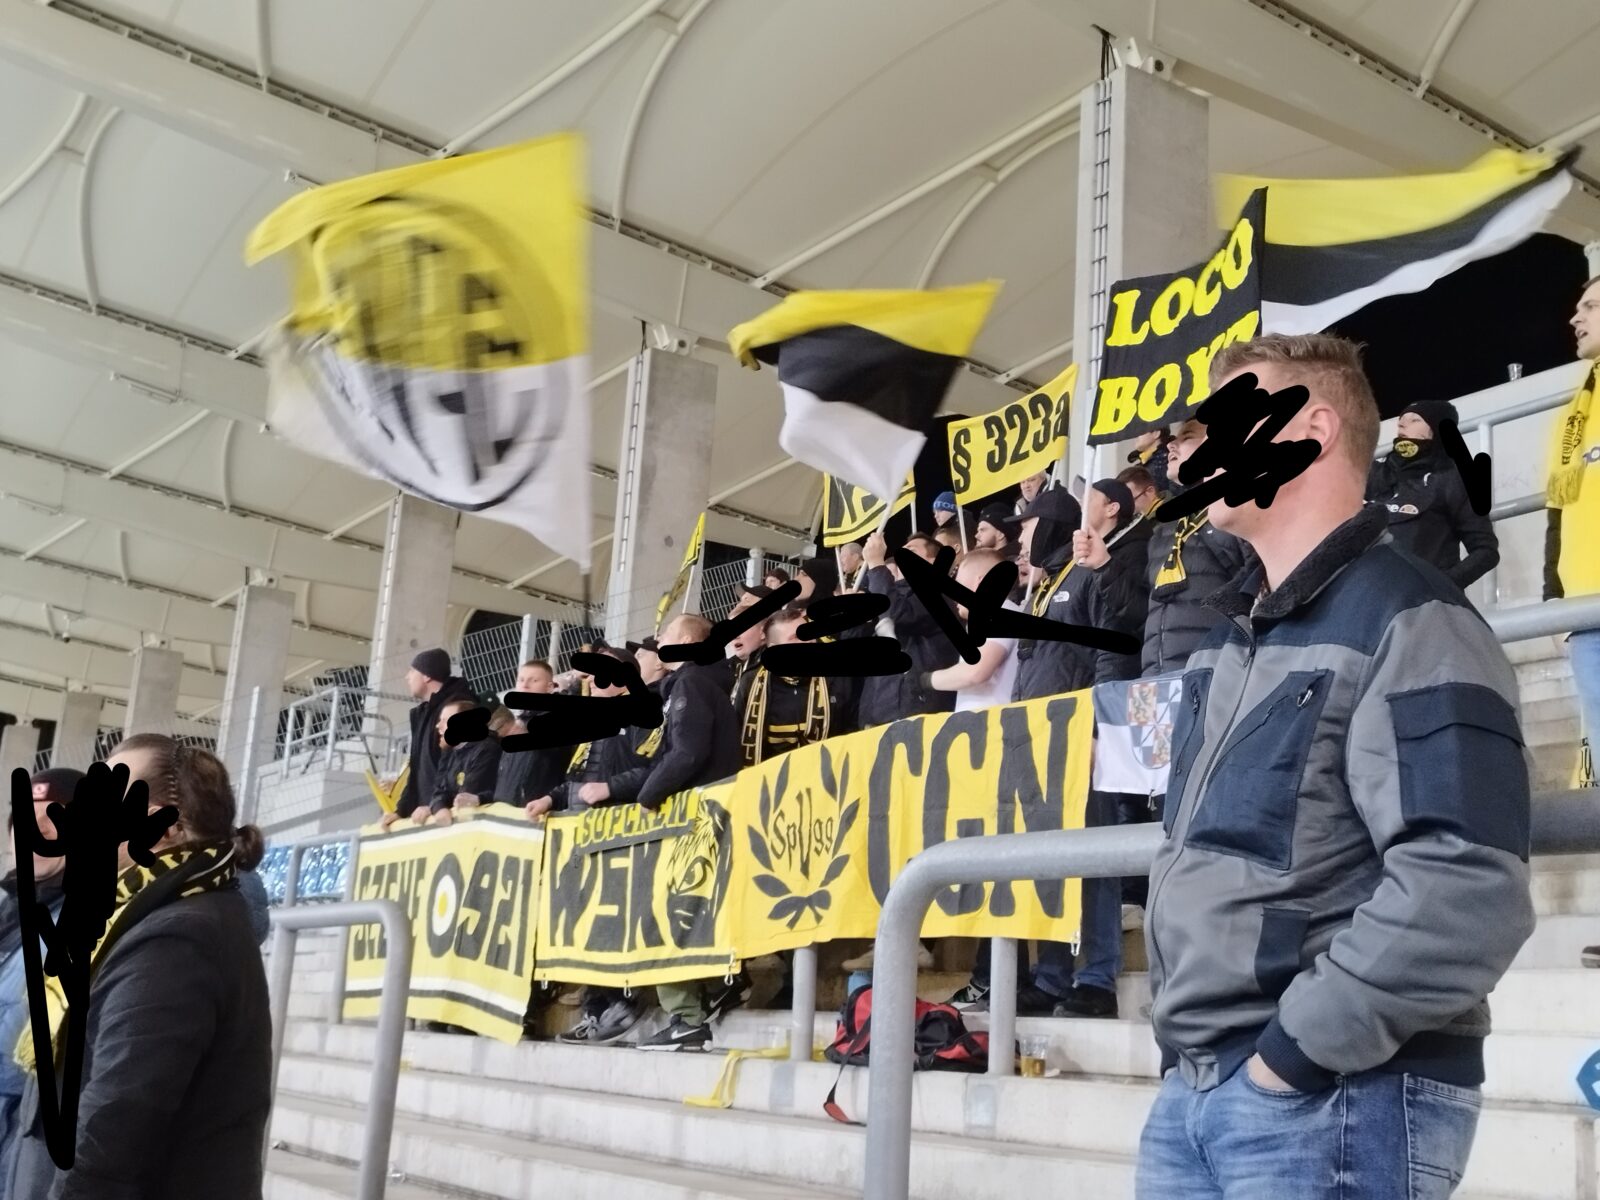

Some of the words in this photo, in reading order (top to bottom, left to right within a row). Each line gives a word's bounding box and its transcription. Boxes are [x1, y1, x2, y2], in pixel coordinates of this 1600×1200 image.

[1106, 218, 1254, 347] LOCO
[952, 427, 972, 495] §
[983, 391, 1070, 473] 323a
[769, 787, 834, 880] SpVgg
